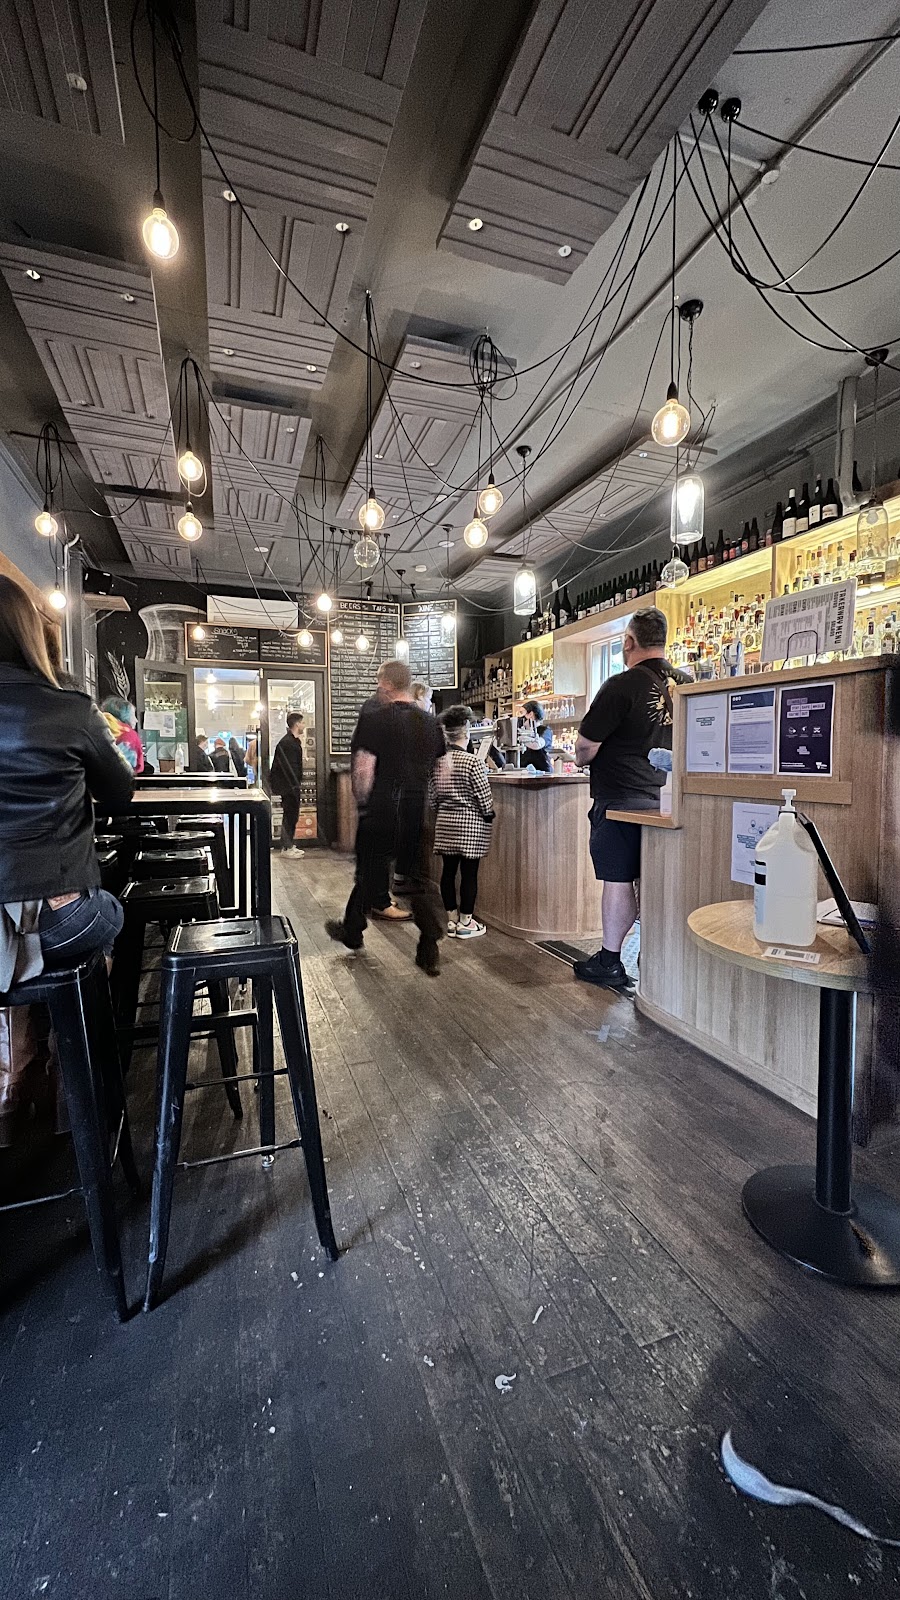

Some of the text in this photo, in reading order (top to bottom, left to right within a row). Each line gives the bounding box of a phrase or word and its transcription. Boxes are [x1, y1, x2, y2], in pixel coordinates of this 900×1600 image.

[340, 602, 361, 610] BEERS
[834, 588, 847, 644] TAKEAWAY MENU
